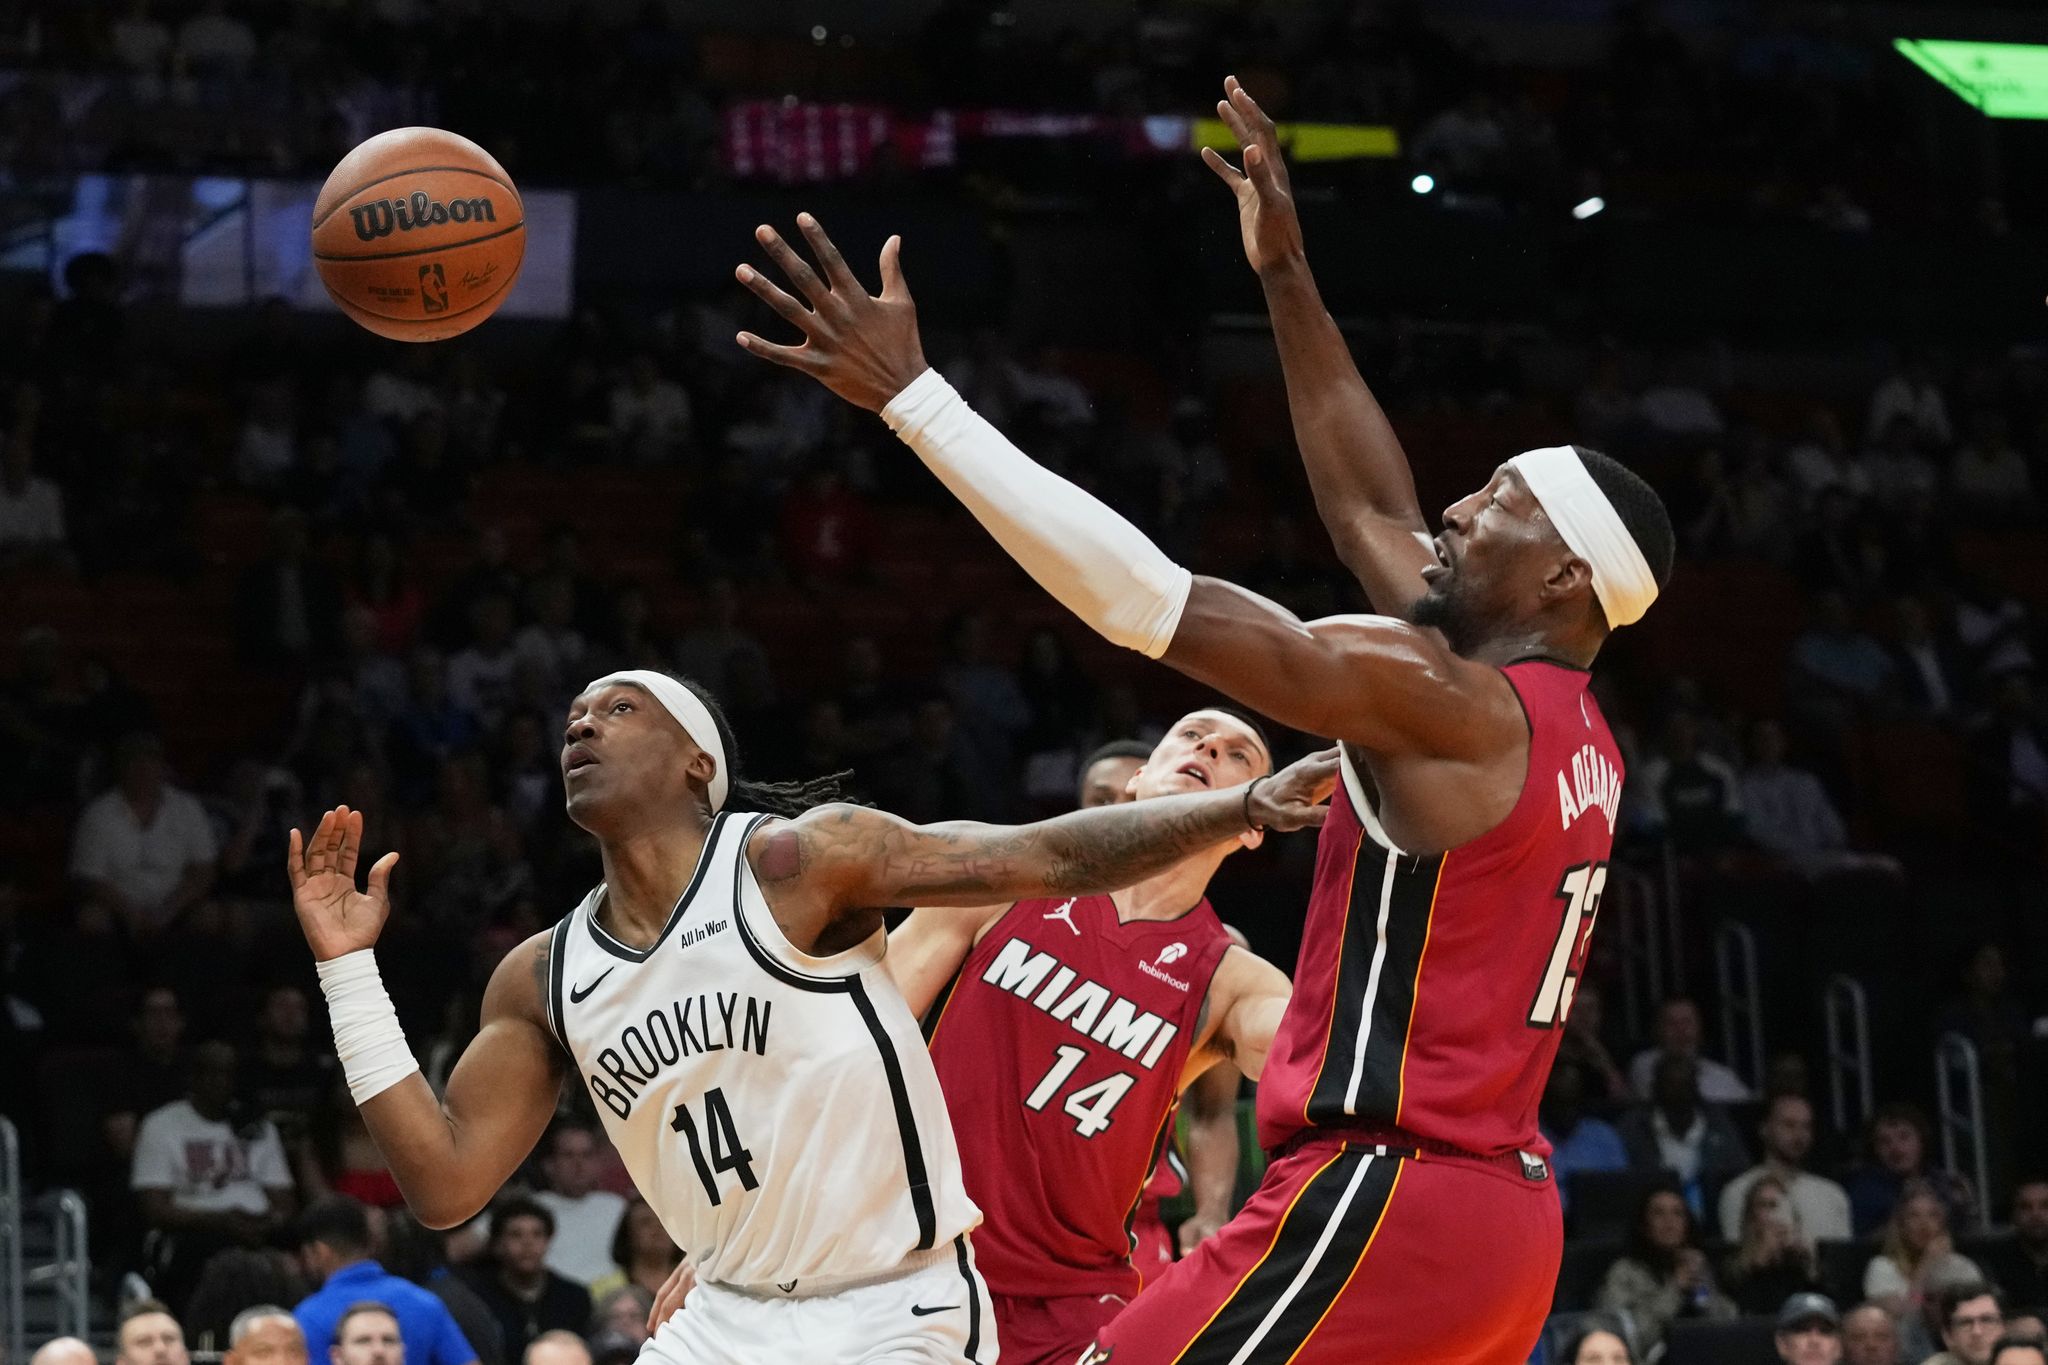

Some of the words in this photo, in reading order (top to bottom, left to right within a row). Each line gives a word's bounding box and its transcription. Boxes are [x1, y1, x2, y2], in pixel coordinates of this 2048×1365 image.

[350, 190, 497, 242] Wilson
[1557, 743, 1622, 836] ADEBAYO
[681, 930, 694, 949] All
[694, 928, 706, 942] In
[704, 920, 728, 937] Won
[1138, 959, 1190, 993] Robinhood
[981, 936, 1180, 1070] MIAMI
[590, 992, 772, 1121] BROOKLYN
[1023, 1043, 1139, 1140] 14
[670, 1086, 760, 1207] 14
